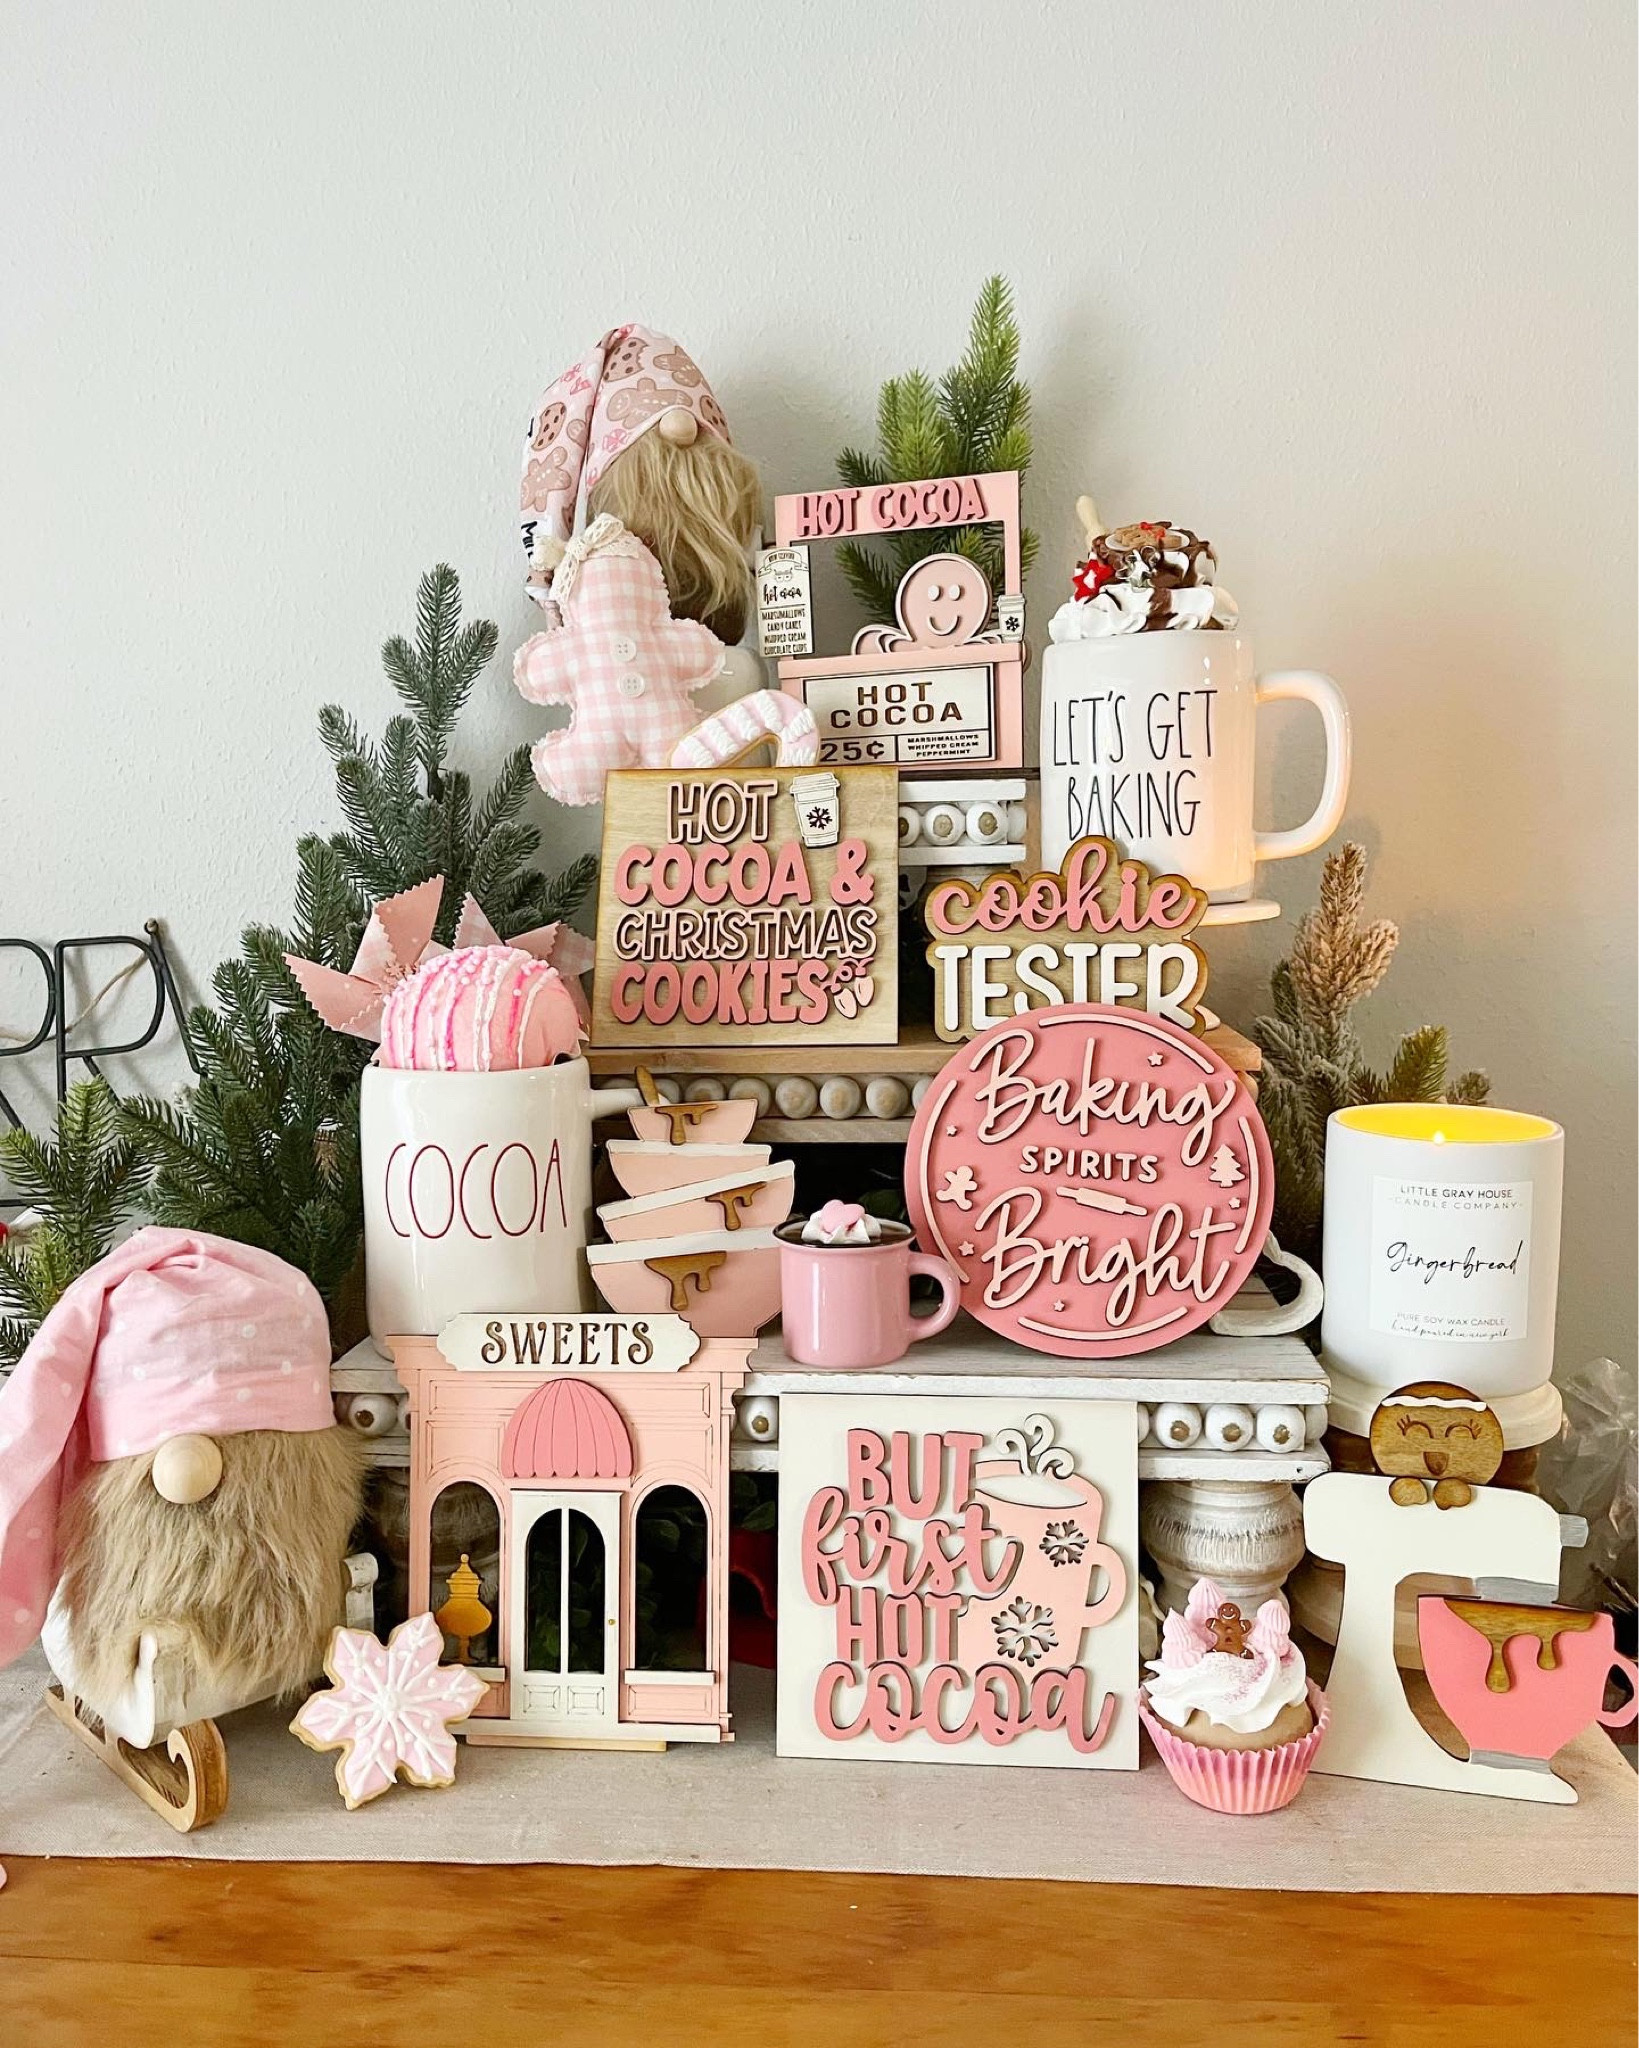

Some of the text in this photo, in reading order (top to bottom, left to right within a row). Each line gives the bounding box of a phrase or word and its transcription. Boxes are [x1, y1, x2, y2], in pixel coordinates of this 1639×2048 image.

[796, 478, 988, 536] HOT COCOA
[830, 702, 963, 729] COCOA
[857, 681, 933, 706] HOT
[820, 740, 885, 761] 25¢
[907, 734, 979, 743] MARSHMALLOWS
[907, 743, 947, 751] WHIPPED
[916, 749, 971, 757] PEPPERMINT
[1053, 690, 1218, 766] LET'S GET
[667, 778, 778, 844] HOT
[1067, 769, 1201, 841] BAKING
[615, 838, 875, 906] COCOA &
[932, 842, 1197, 934] cookie
[614, 906, 878, 961] CHRISTMAS
[611, 959, 829, 1025] COOKIES
[934, 942, 1199, 1032] TESTER
[969, 1028, 1237, 1167] Baking
[385, 1138, 567, 1239] COCOA
[1019, 1145, 1159, 1184] SPIRITS
[1400, 1186, 1513, 1199] LITTLE GRAY HOUSE
[1394, 1197, 1518, 1210] CANDLE COMPANY
[974, 1186, 1237, 1327] Bright
[1386, 1239, 1524, 1285] Gingerbread
[481, 1321, 654, 1365] SWEETS
[1424, 1315, 1445, 1324] SOY
[1470, 1317, 1506, 1326] CANDLE
[848, 1428, 984, 1520] BUT
[802, 1486, 1024, 1606] first
[836, 1585, 962, 1669] HOT
[814, 1661, 1115, 1754] cocoa
